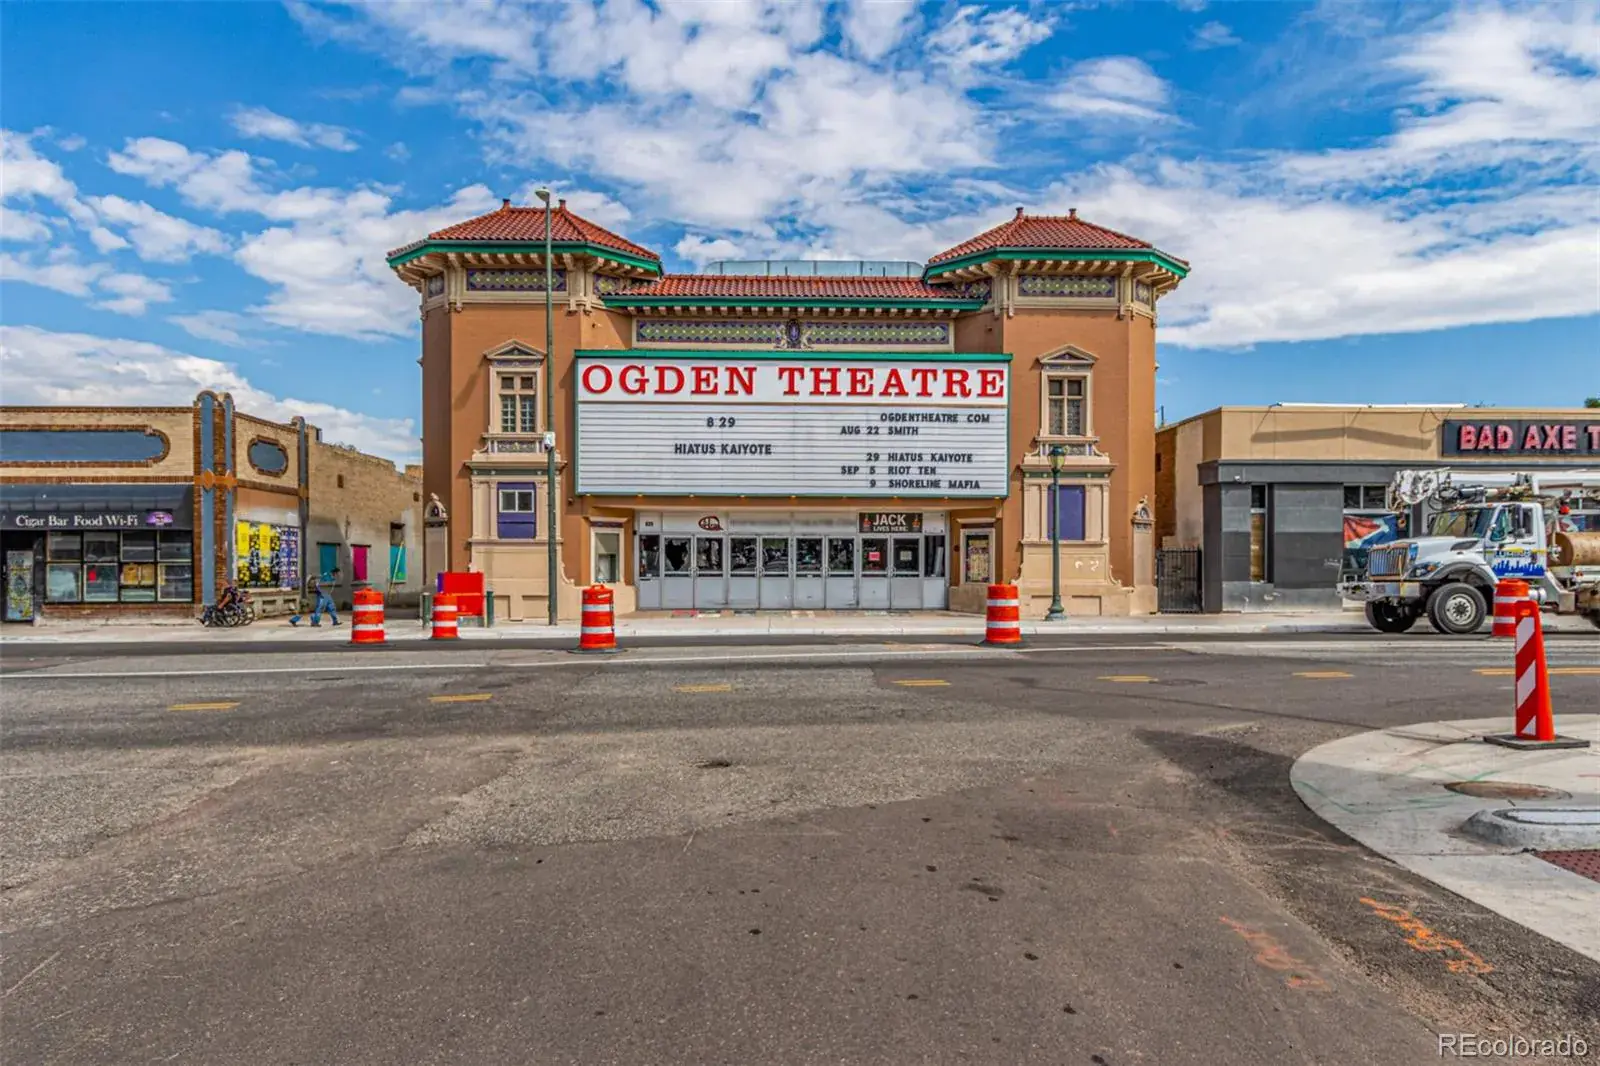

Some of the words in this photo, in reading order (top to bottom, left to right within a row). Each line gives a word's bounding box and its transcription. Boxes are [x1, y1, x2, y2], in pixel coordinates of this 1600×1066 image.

[582, 364, 757, 395] OGDEN
[778, 367, 1004, 398] THEATRE
[880, 413, 958, 423] OGDENTHEATRE
[967, 413, 990, 423] COM
[840, 426, 860, 435] AUG
[866, 426, 880, 435] 22
[888, 426, 919, 436] SMITH
[1459, 424, 1514, 450] BAD
[1523, 424, 1577, 450] AXE
[674, 443, 716, 455] HIATUS
[720, 443, 772, 455] KAIYOTE
[866, 452, 880, 462] 29
[888, 452, 923, 462] HIATUS
[930, 453, 973, 463] KAIYOTE
[841, 465, 860, 475] SEP
[869, 466, 876, 475] 5
[888, 466, 911, 475] RIOT
[918, 466, 937, 475] TEN
[869, 479, 876, 488] 9
[888, 479, 941, 489] SHORELINE
[948, 480, 980, 489] MAFIA
[15, 514, 44, 527] Cigar
[49, 514, 69, 526] Bar
[73, 514, 103, 526] Food
[105, 514, 138, 526] Wi-Fi
[873, 514, 907, 526] JACK
